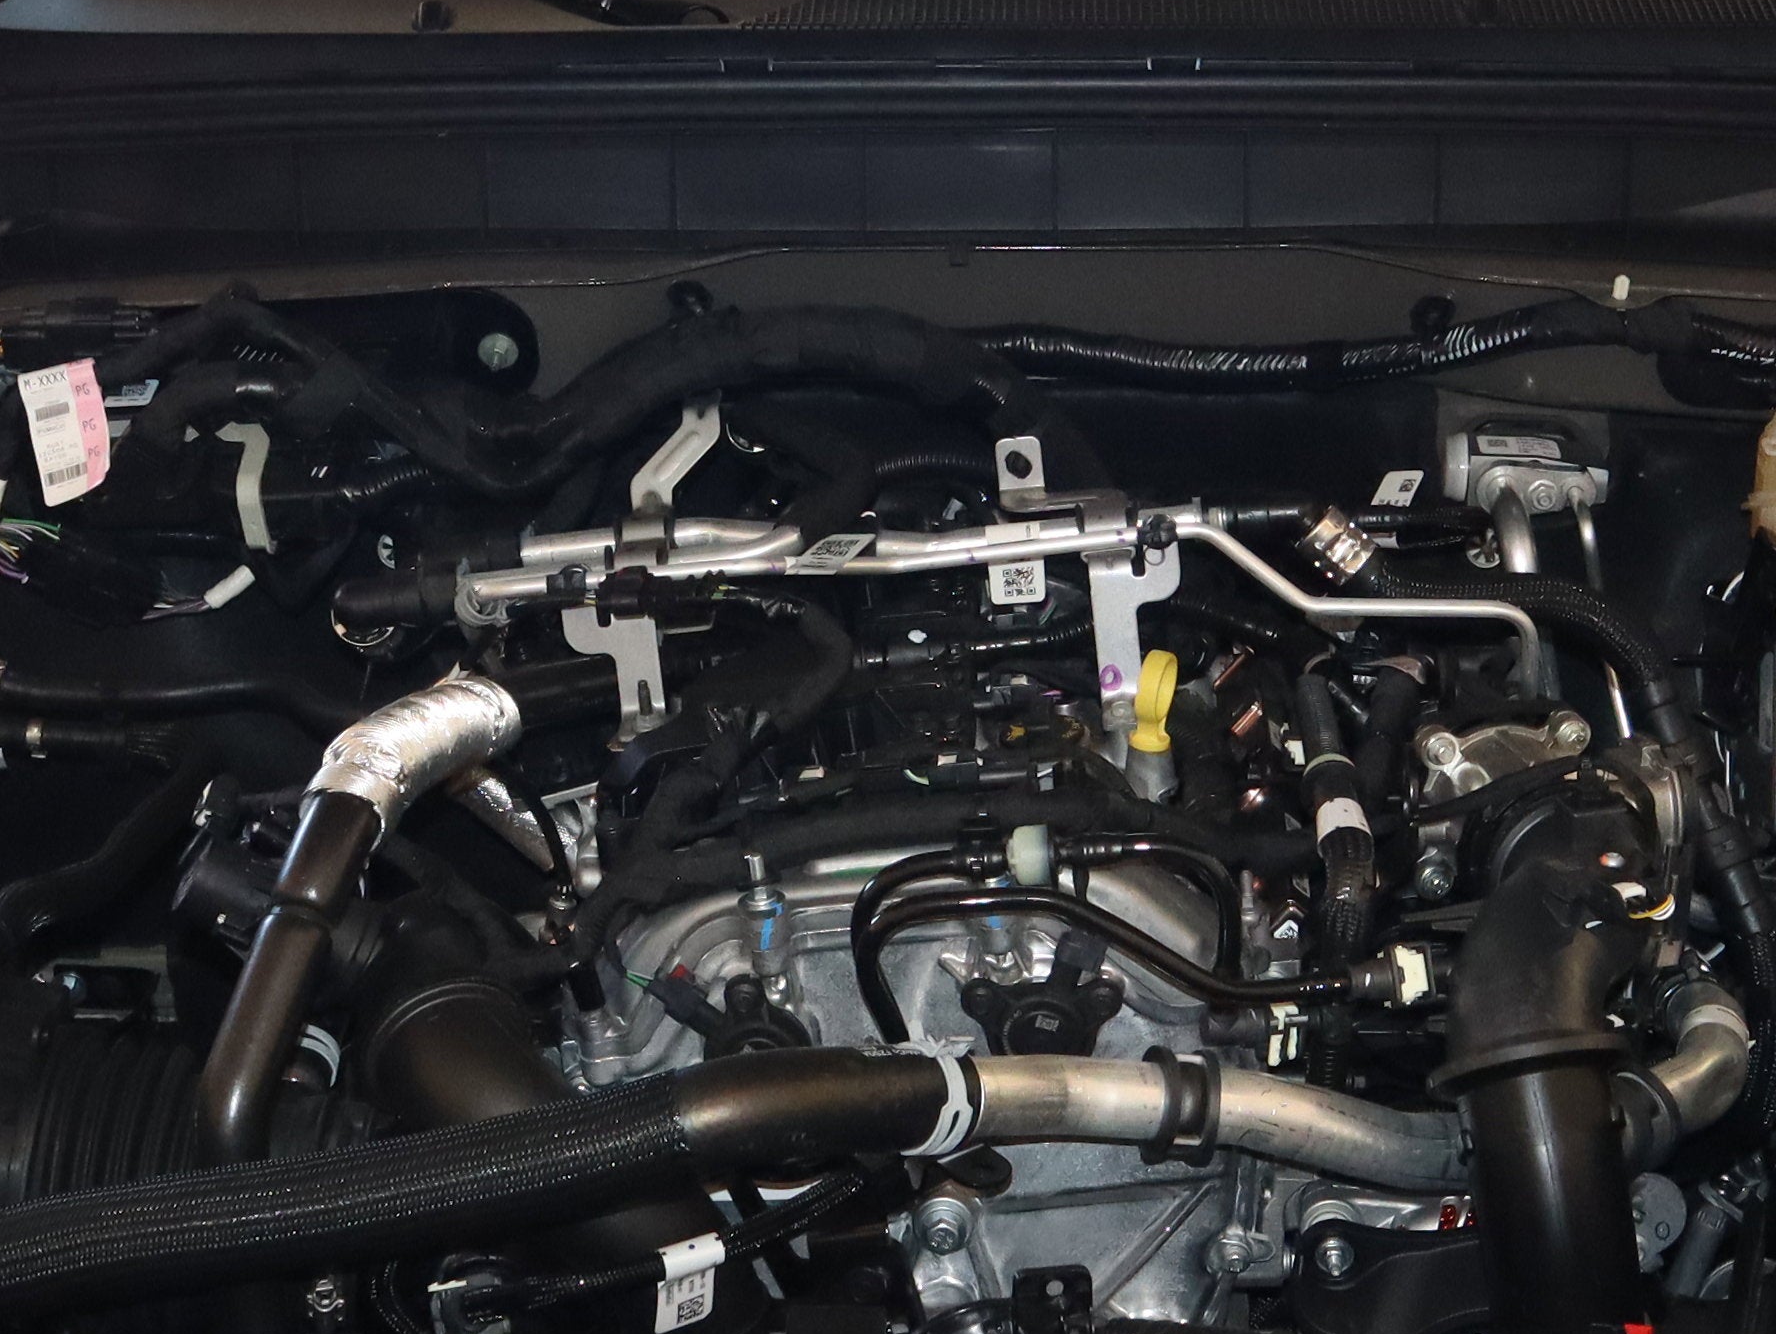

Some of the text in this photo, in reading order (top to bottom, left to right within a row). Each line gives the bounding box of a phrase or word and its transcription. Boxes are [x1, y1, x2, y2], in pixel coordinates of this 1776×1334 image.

[24, 370, 67, 390] M-XXXX
[75, 382, 90, 397] PG
[82, 418, 97, 432] PG
[88, 445, 100, 458] PG
